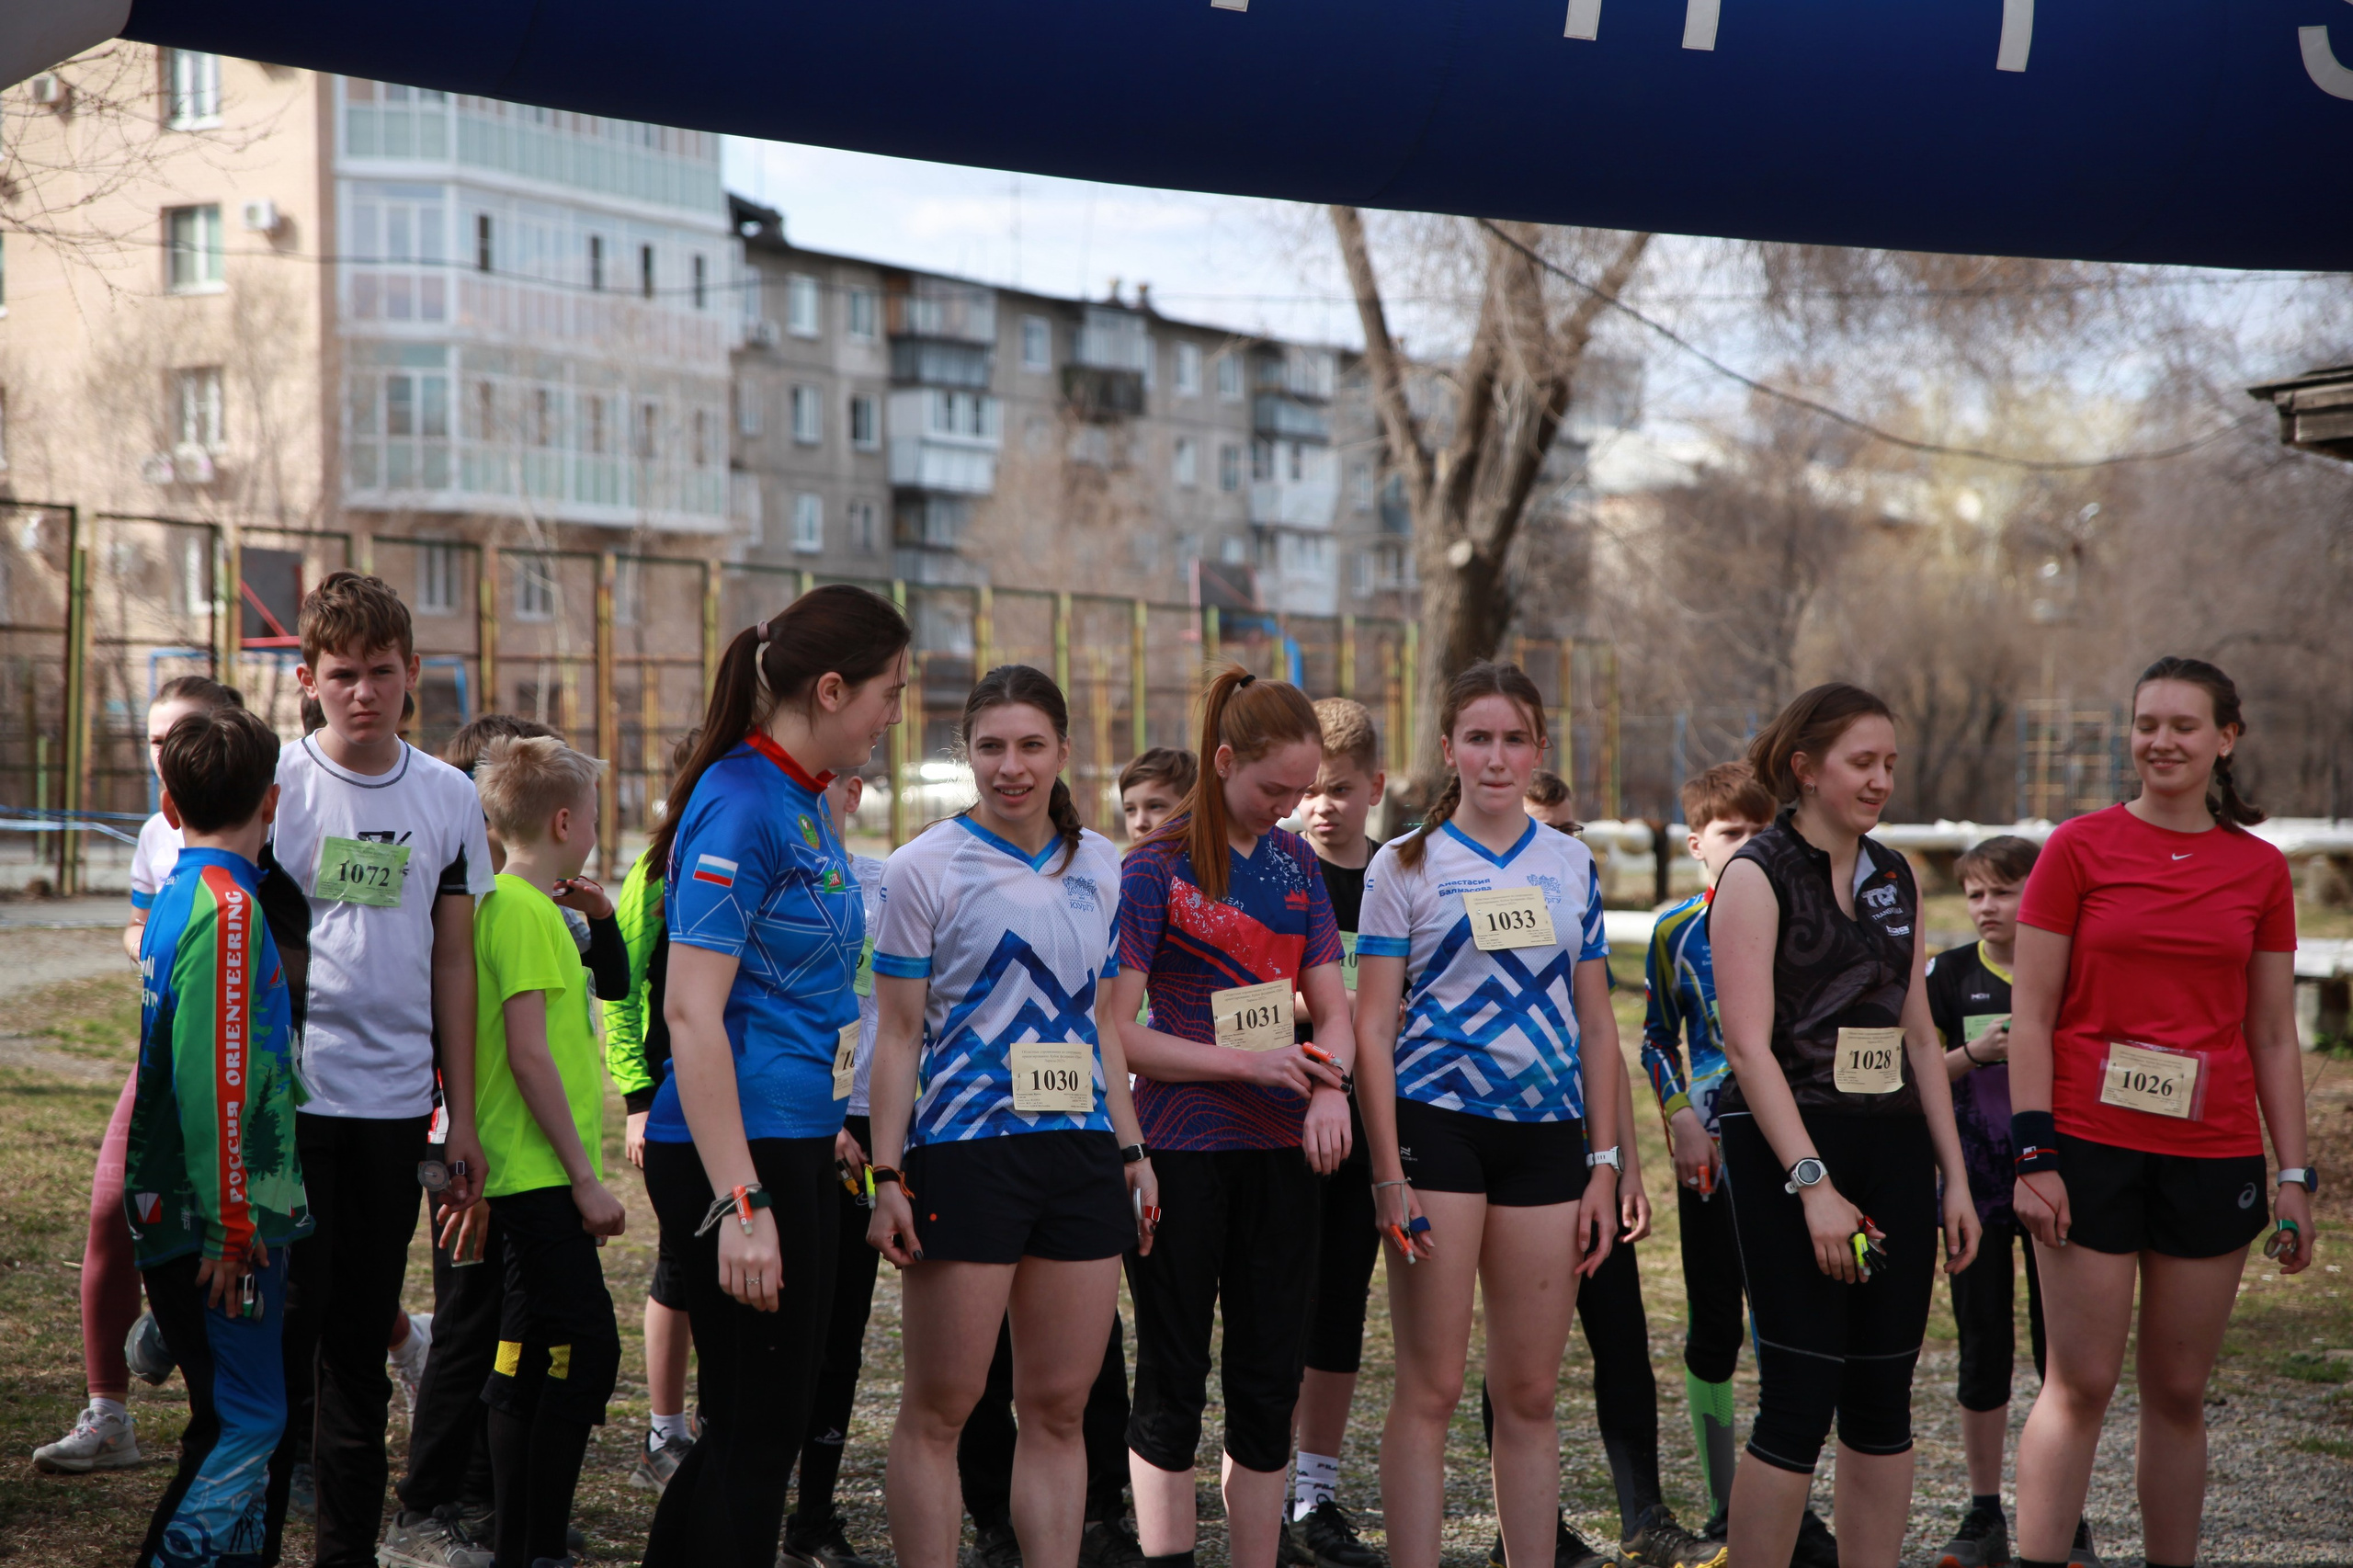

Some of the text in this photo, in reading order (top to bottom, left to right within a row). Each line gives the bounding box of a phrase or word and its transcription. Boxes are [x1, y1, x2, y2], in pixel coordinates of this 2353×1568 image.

[338, 859, 391, 888] 1072
[1437, 878, 1491, 889] Анастасия
[1485, 909, 1536, 932] 1033
[225, 890, 243, 1086] ORIENTEERING
[1233, 1004, 1280, 1031] 1031
[1850, 1050, 1892, 1070] 1028
[1030, 1069, 1079, 1092] 1030
[2121, 1071, 2174, 1096] 1026
[1317, 1462, 1338, 1471] FILA
